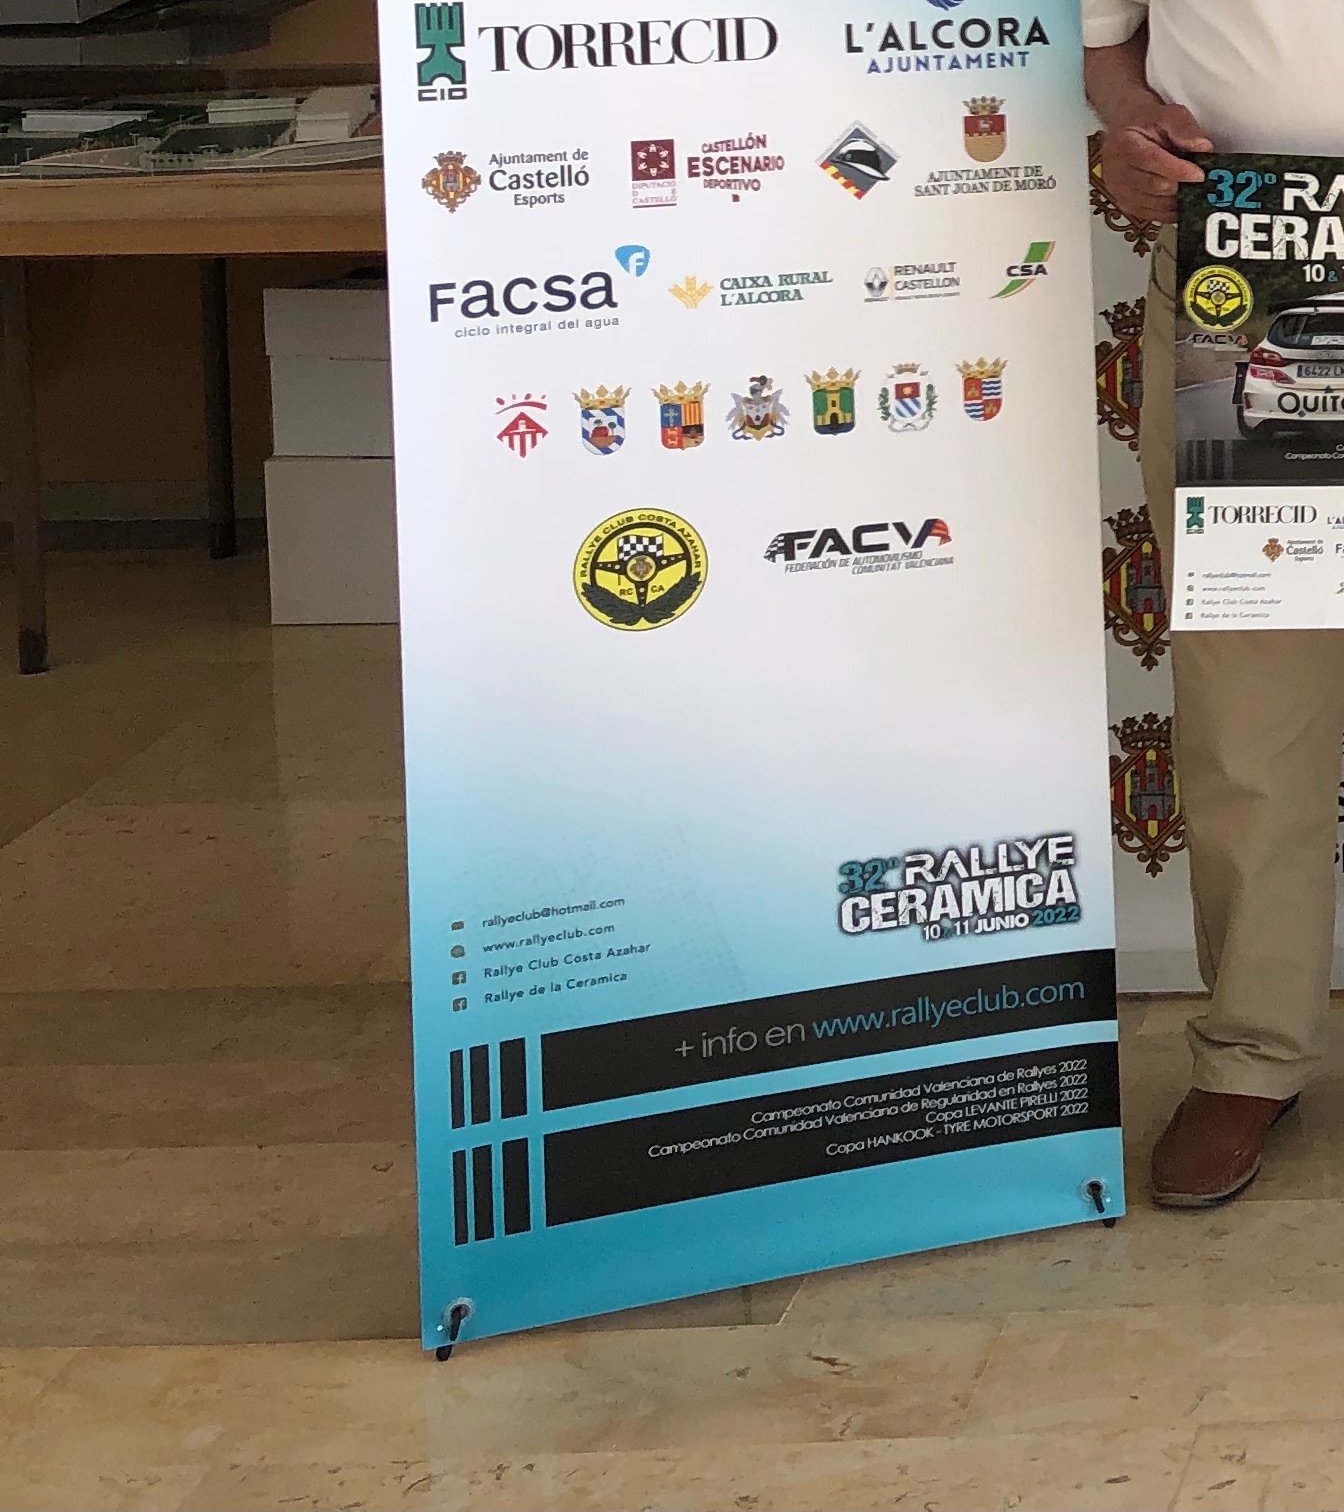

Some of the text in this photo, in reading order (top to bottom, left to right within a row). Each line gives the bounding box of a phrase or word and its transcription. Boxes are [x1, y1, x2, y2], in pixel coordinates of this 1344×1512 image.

[478, 16, 778, 73] TORRECID
[866, 51, 1030, 75] AJUNTAMENT
[489, 149, 589, 168] Ajuntament de
[687, 154, 785, 178] ESCENARIO
[488, 166, 590, 193] Castelló
[703, 177, 762, 192] DEPORTIVO
[1022, 166, 1043, 179] DE
[513, 190, 566, 208] Esports
[719, 269, 833, 292] CAIXA RURAL
[893, 261, 958, 278] RENAULT
[1005, 262, 1048, 278] CSA
[1301, 263, 1326, 283] 10
[454, 316, 621, 340] ciclo integral del agua
[904, 835, 1075, 886] RALLYE
[481, 895, 626, 929] rallyeclub@hotmail.com
[838, 867, 1078, 936] CERAMICA
[921, 904, 1081, 941] 10 11 JUNIO 2022
[482, 923, 616, 954] www.rallyeclub.com
[483, 941, 651, 980] Rallye Club Costa Azahar
[484, 972, 627, 1007] Rallye de la Ceramica
[701, 977, 1085, 1060] info en www.rallyeclub.com
[750, 1057, 1087, 1125] Campeonato Comunidad Valenciana de Rallyes 2022
